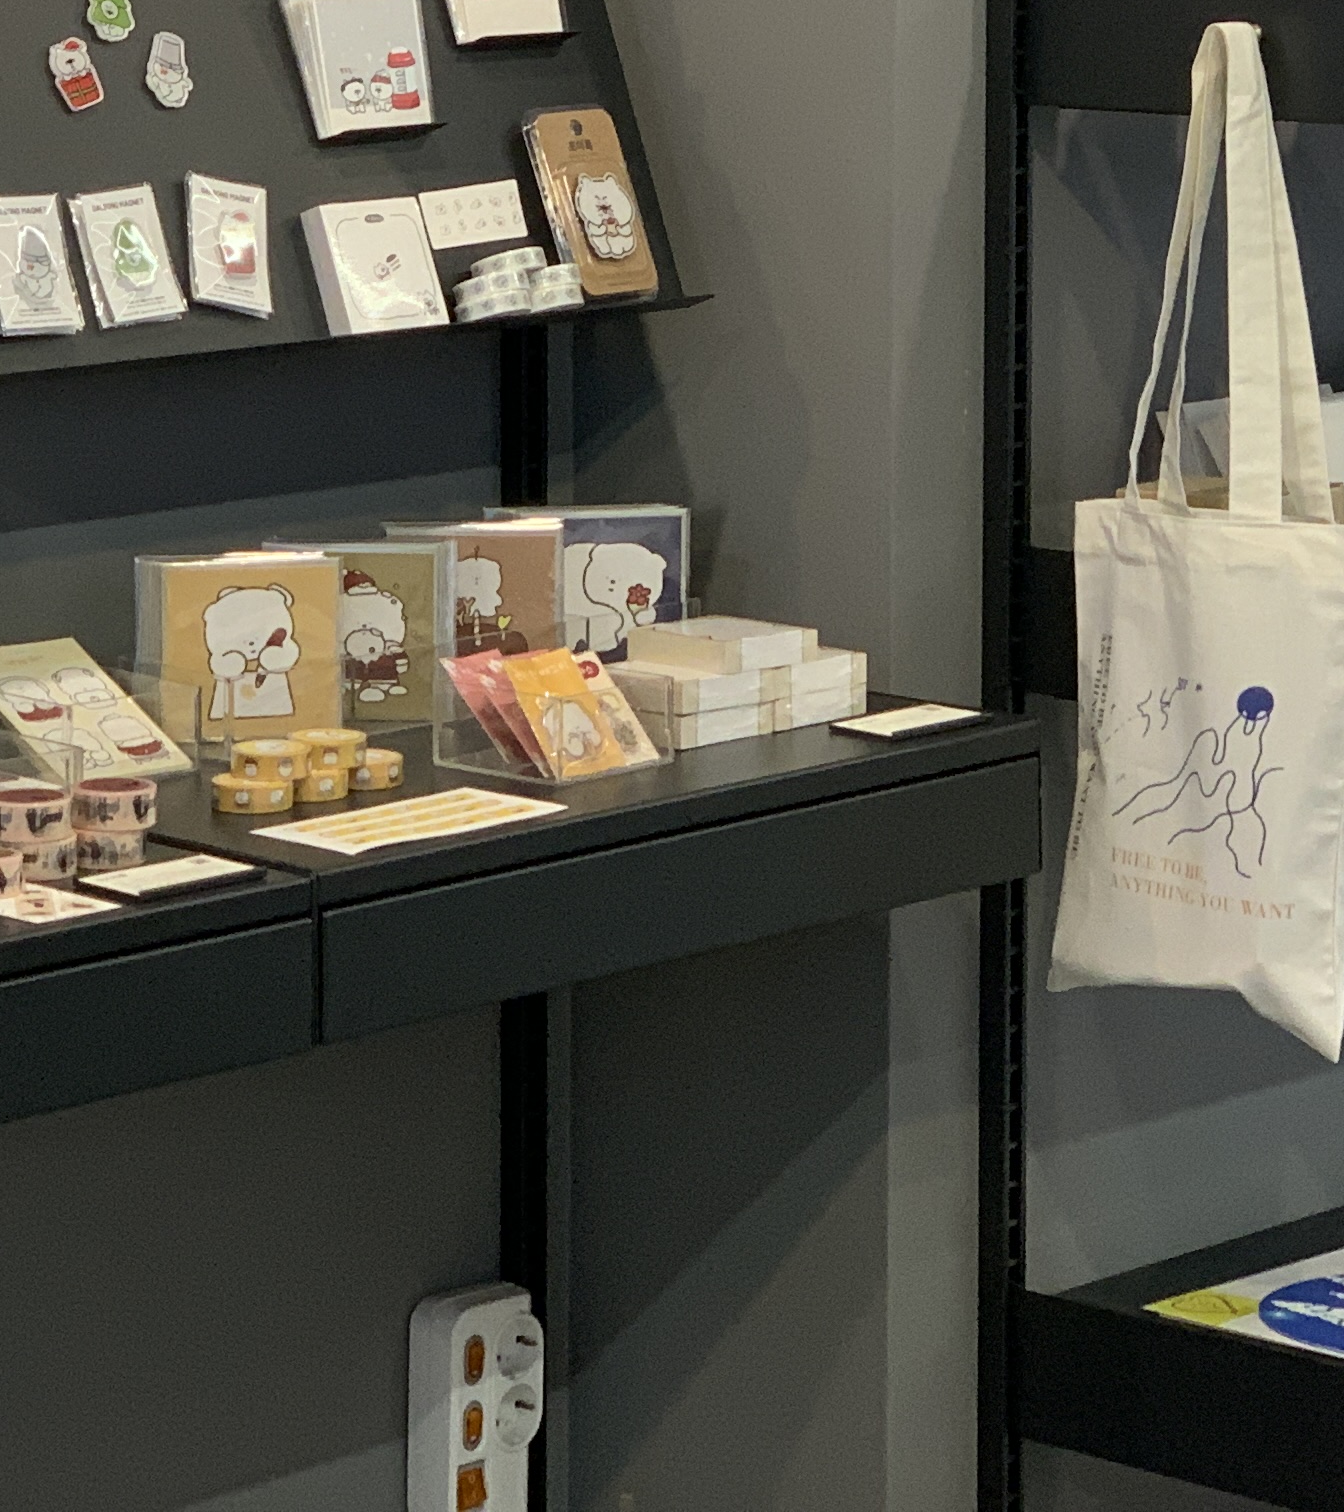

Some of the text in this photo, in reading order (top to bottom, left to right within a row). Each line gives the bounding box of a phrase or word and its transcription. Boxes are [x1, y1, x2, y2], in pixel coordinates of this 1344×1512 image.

[1110, 845, 1156, 870] FREE
[1159, 857, 1182, 876] TO
[1109, 872, 1296, 920] ANYTHING YOU WANT
